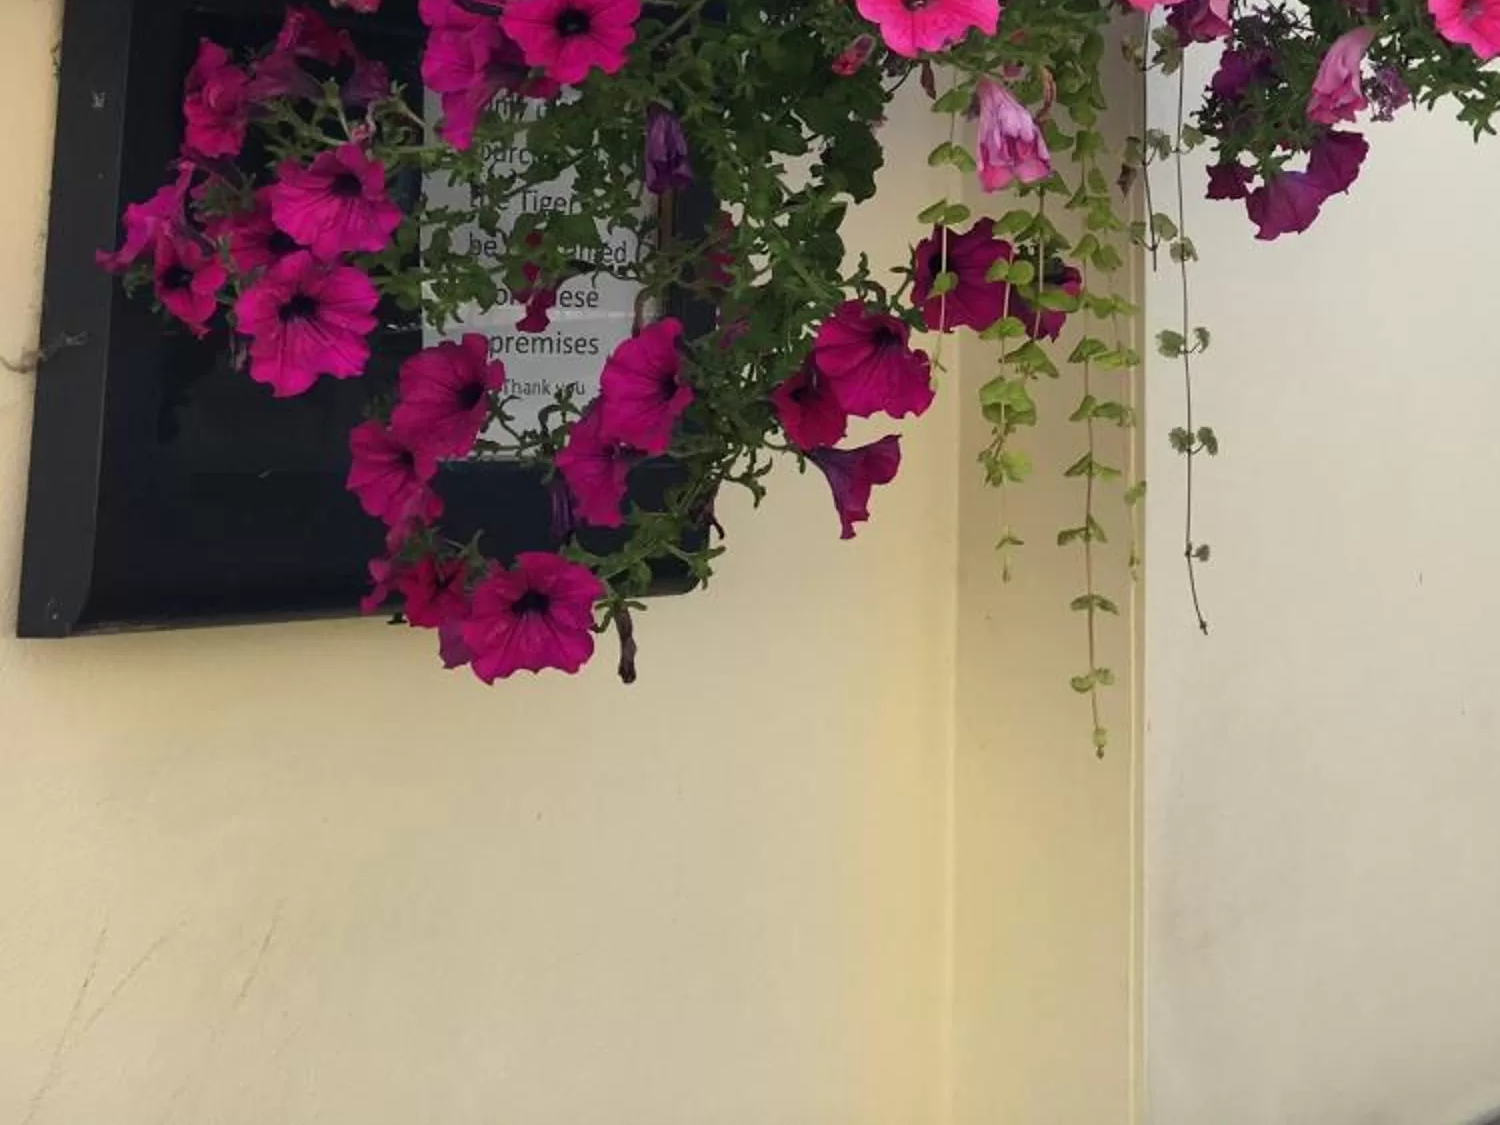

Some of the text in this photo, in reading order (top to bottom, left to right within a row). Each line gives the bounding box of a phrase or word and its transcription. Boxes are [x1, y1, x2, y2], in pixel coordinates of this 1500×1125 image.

[469, 231, 497, 256] be
[558, 289, 600, 308] ese
[489, 331, 600, 358] premises
[502, 378, 551, 396] Thank
